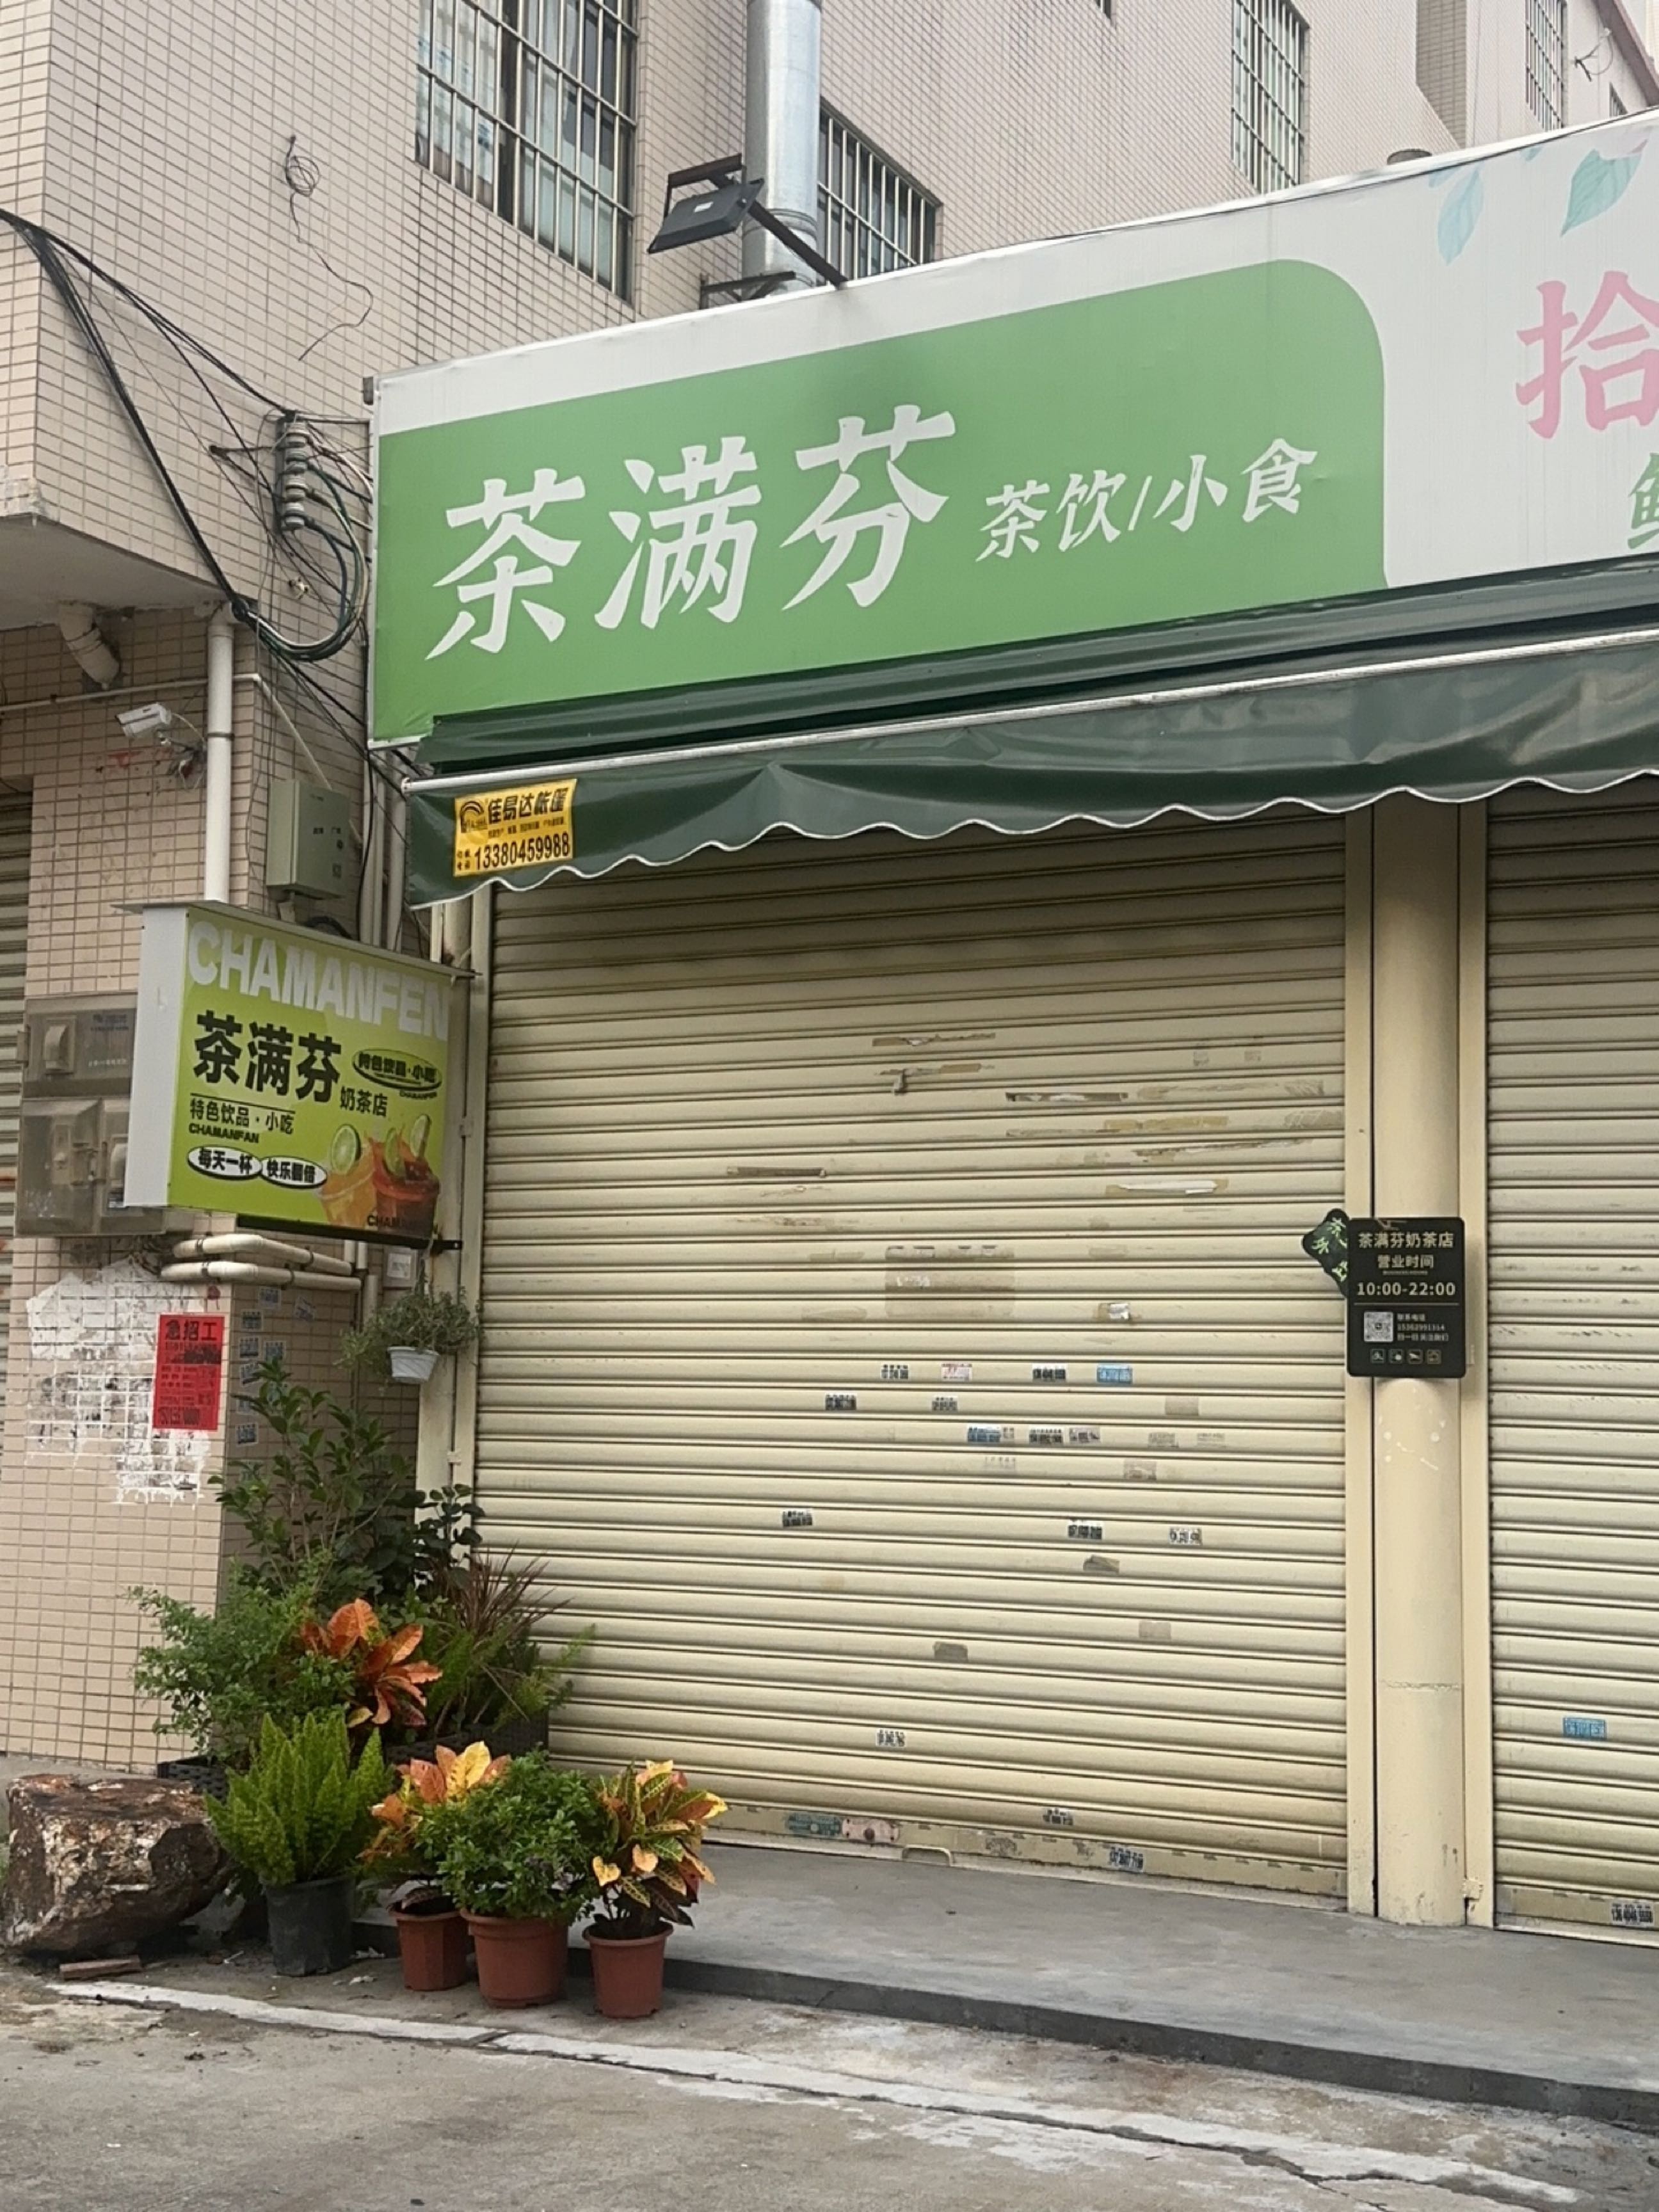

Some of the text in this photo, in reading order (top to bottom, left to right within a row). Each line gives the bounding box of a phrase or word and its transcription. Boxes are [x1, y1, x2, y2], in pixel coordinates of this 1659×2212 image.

[975, 438, 1318, 562] 茶饮/小食
[425, 405, 956, 661] 茶满芬
[475, 832, 571, 870] 13380459988
[188, 921, 447, 1041] CHAMANFEN
[193, 1009, 342, 1103] 茶满芬
[189, 1098, 294, 1135] 特色饮品·小吃
[339, 1086, 388, 1117] 奶茶店
[189, 1123, 259, 1144] CHAMANFAN
[198, 1146, 253, 1174] 每天一杯
[1358, 1232, 1454, 1249] 茶满芬奶茶店
[1377, 1254, 1434, 1269] 营业时间
[1356, 1281, 1456, 1296] 10:00-22:00
